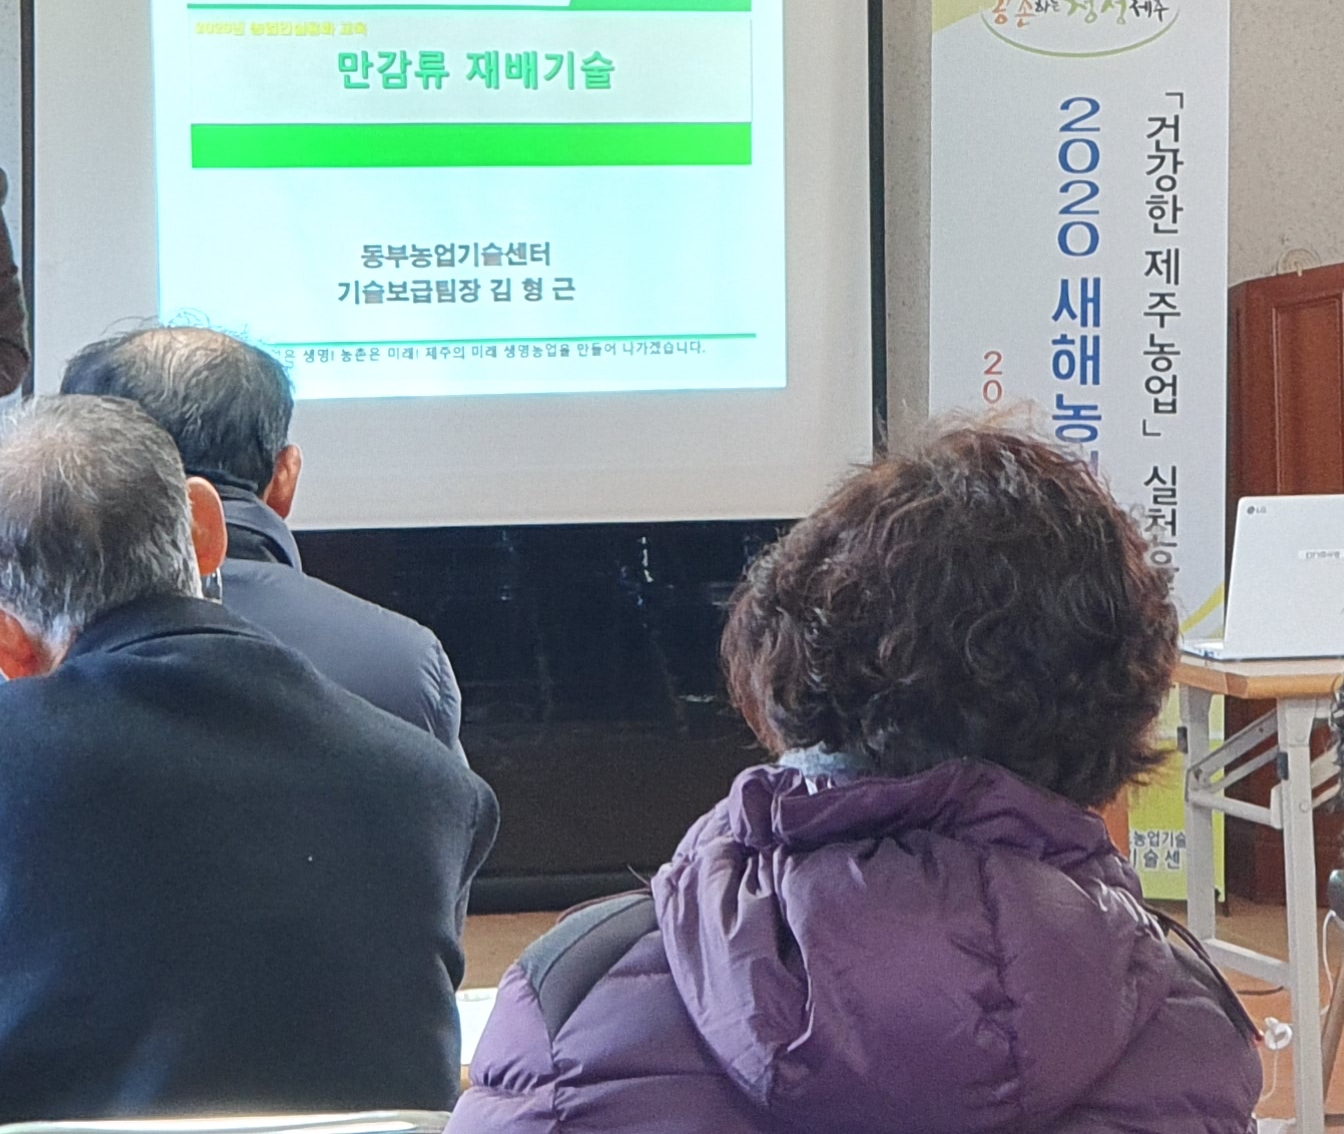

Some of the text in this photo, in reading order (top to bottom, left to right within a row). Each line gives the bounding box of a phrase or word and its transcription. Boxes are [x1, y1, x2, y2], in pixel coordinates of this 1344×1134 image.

[338, 50, 616, 91] 만감류 재배기술
[361, 241, 551, 269] 동부농업기술센터
[338, 278, 481, 305] 기술보급팀장
[1051, 97, 1102, 478] 2020 새해농
[340, 348, 381, 363] 농촌은
[425, 346, 466, 361] 제주의
[471, 345, 497, 359] 미래
[577, 343, 617, 357] 만들어
[622, 340, 706, 356] 나가겠습니다.
